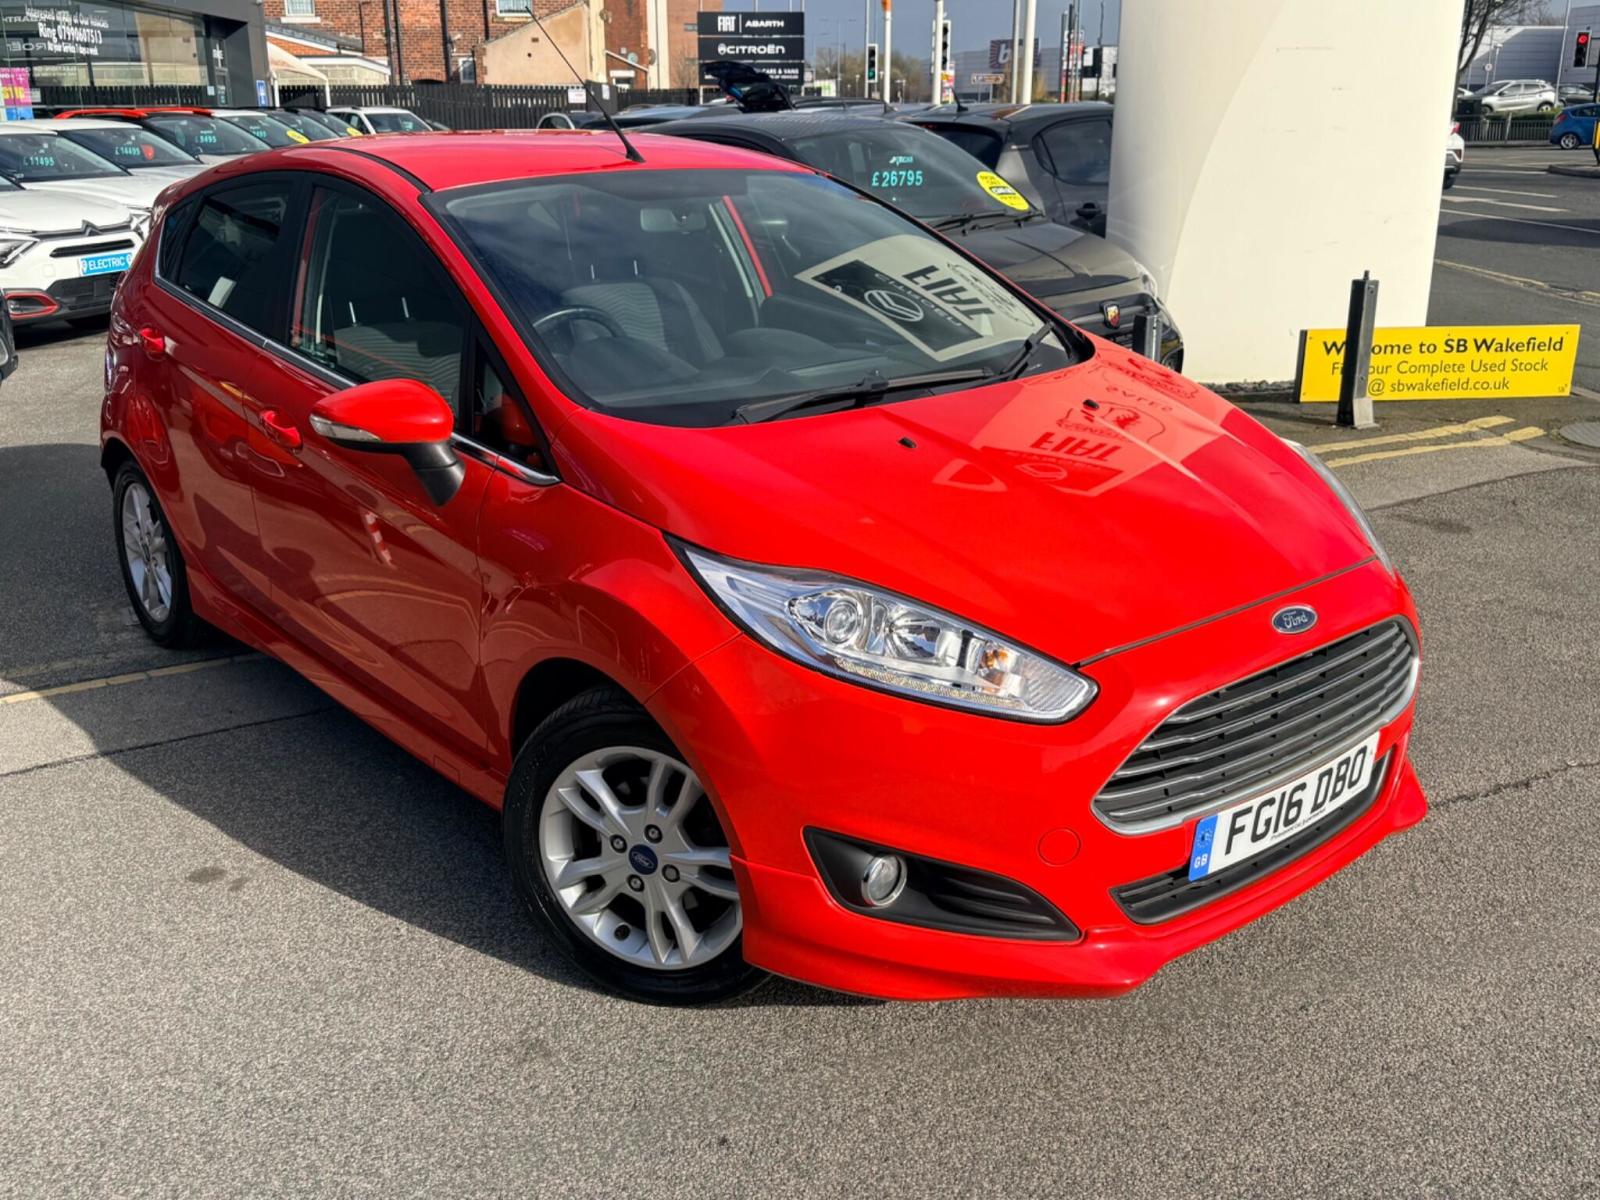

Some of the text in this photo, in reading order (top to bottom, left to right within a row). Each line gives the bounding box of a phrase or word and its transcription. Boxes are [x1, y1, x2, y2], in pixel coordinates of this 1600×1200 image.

[38, 22, 57, 43] Ring
[717, 16, 784, 32] FIAT ABARTH
[872, 170, 923, 187] £26795
[88, 254, 126, 271] ELECTRIC
[1323, 336, 1564, 355] Wome to SB Wakefield
[1397, 359, 1465, 377] Complete
[1470, 359, 1506, 372] Used
[1511, 358, 1549, 372] Stock
[1391, 377, 1510, 392] sbwakefield.co.uk
[1283, 611, 1308, 628] Ford
[1225, 782, 1307, 856] FG16
[1310, 745, 1368, 814] DBO
[1194, 853, 1208, 869] GB
